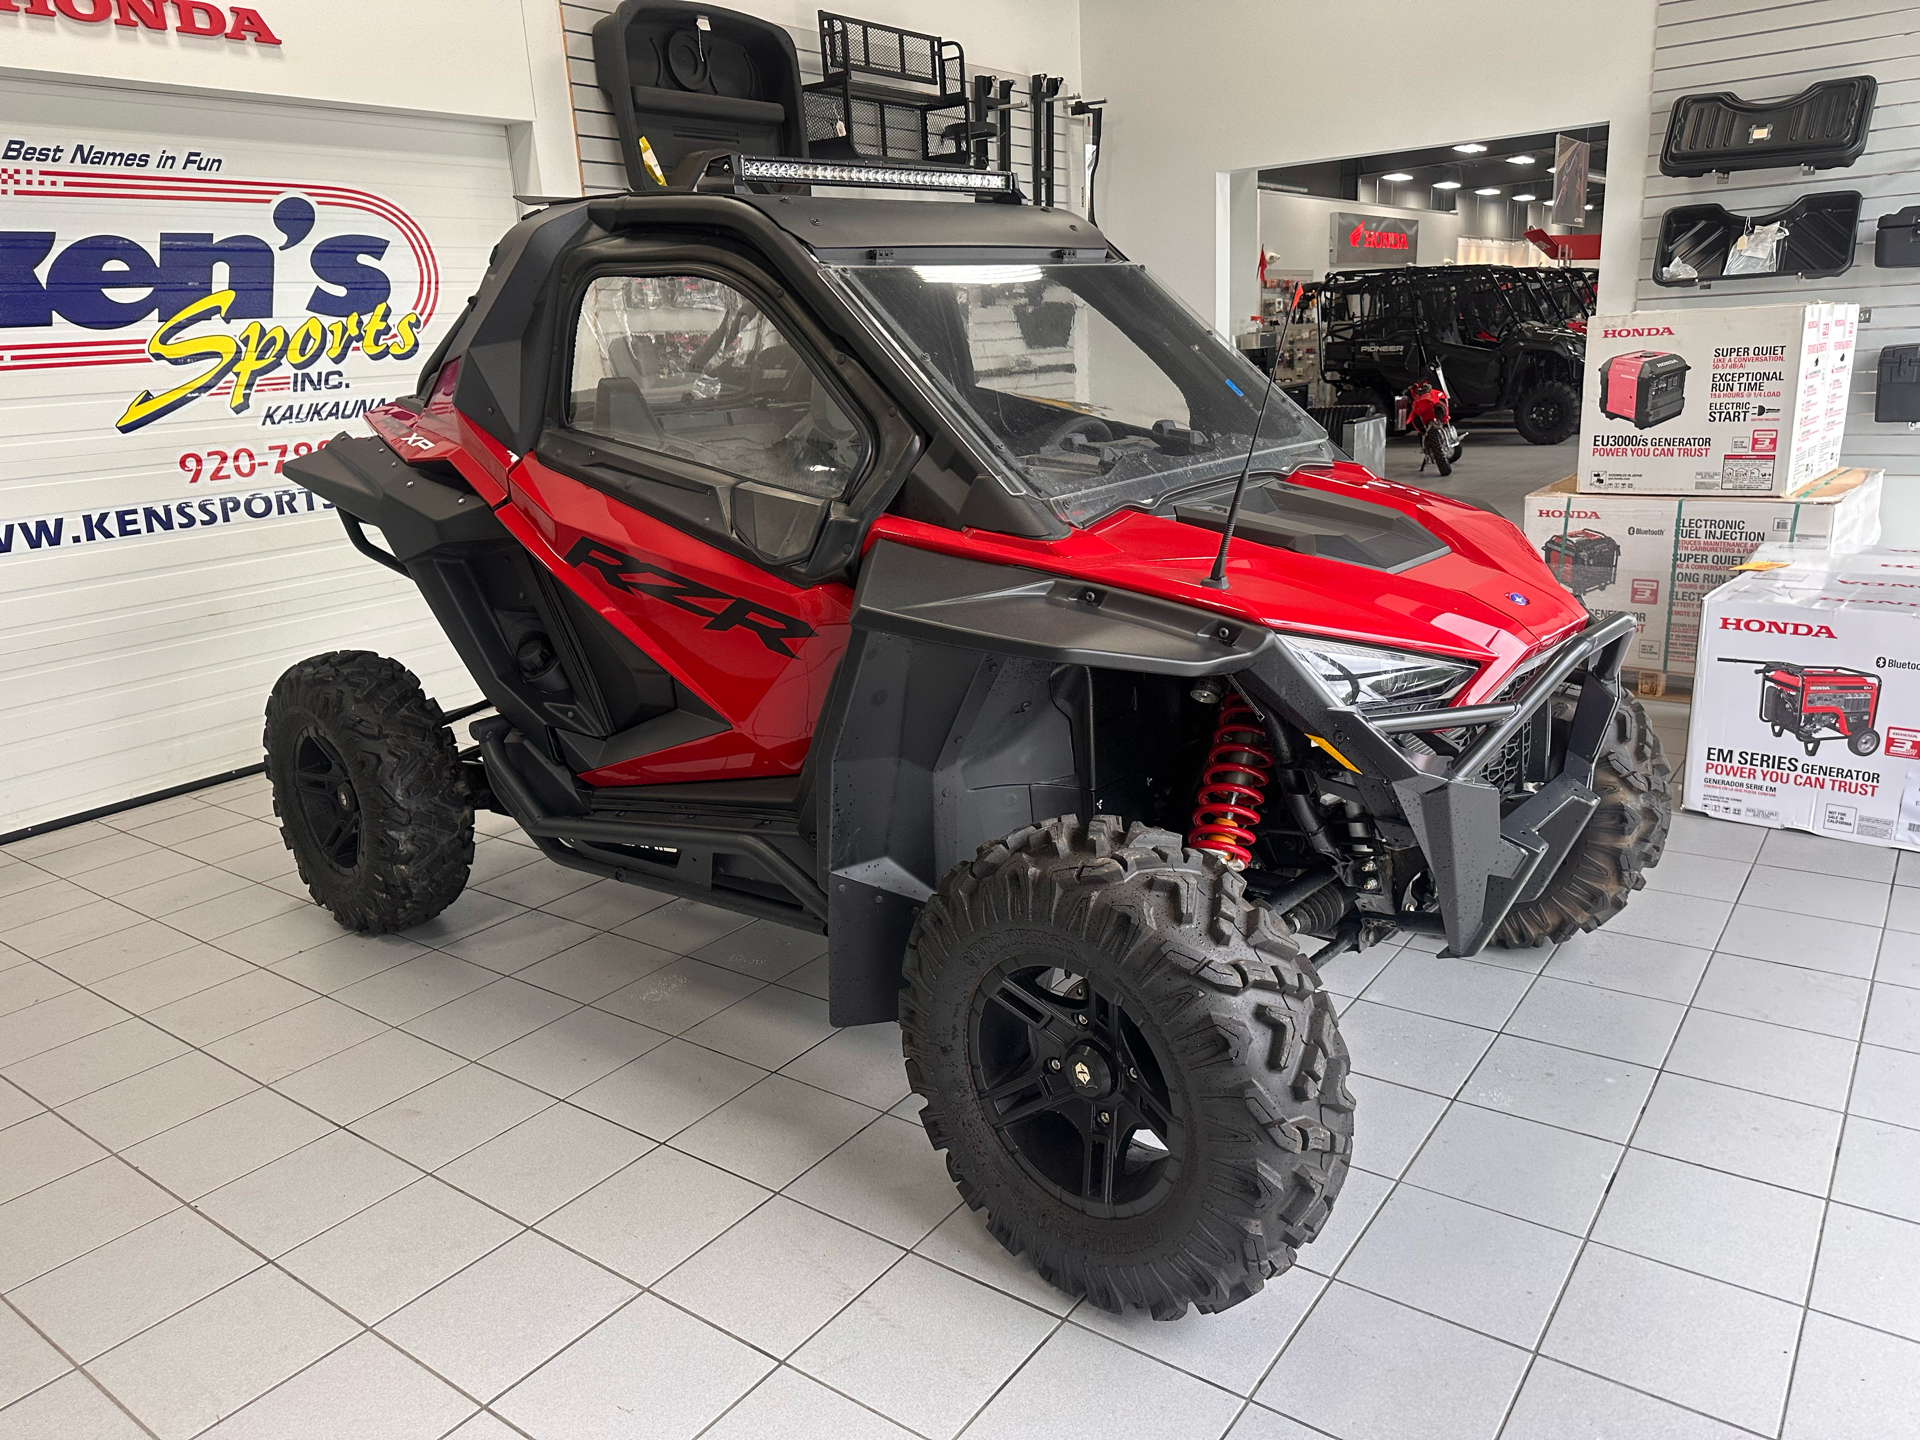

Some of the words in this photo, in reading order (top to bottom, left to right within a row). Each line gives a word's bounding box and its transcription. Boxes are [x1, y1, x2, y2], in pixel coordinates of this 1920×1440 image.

[1, 139, 64, 163] Best
[70, 144, 150, 168] Names
[156, 150, 176, 169] in
[182, 152, 222, 172] Fun
[1364, 230, 1409, 250] HONDA
[1602, 326, 1675, 338] HONDA
[1714, 347, 1750, 358] SUPER
[1753, 345, 1787, 357] QUIET
[116, 289, 422, 434] Sports
[292, 371, 351, 393] INC.
[1712, 371, 1785, 383] EXCEPTIONAL
[1711, 382, 1735, 392] RUN
[1737, 381, 1765, 392] TIME
[1723, 391, 1745, 399] HOURS
[1709, 402, 1751, 411] ELECTRIC
[1708, 411, 1750, 422] START
[400, 432, 436, 450] XP
[1593, 434, 1649, 447] EU3000is
[1650, 437, 1711, 447] GENERATOR
[1592, 448, 1628, 457] POWER
[1630, 448, 1651, 457] YOU
[1652, 448, 1675, 457] CAN
[1677, 448, 1711, 457] TRUST
[1537, 509, 1602, 519] HONDA
[1680, 518, 1746, 530] LECTRONIC
[1635, 528, 1664, 536] Bluetooth
[1679, 529, 1701, 539] UEL
[1704, 530, 1766, 541] INJECTION
[1711, 554, 1745, 566] QUIET
[1675, 572, 1699, 583] ONG
[1703, 574, 1726, 584] RUN
[564, 536, 820, 661] RZR
[1719, 617, 1838, 639] HONDA
[1892, 731, 1919, 739] HONDA
[1707, 747, 1733, 764] EM
[1737, 751, 1800, 773] SERIES
[1801, 763, 1881, 784] GENERATOR
[1703, 777, 1744, 788] GENERADOR
[1745, 783, 1765, 791] SERIE
[1765, 785, 1777, 793] EM
[1705, 762, 1757, 780] POWER
[1760, 769, 1790, 784] YOU
[1793, 774, 1826, 790] CAN
[1829, 778, 1880, 797] TRUST
